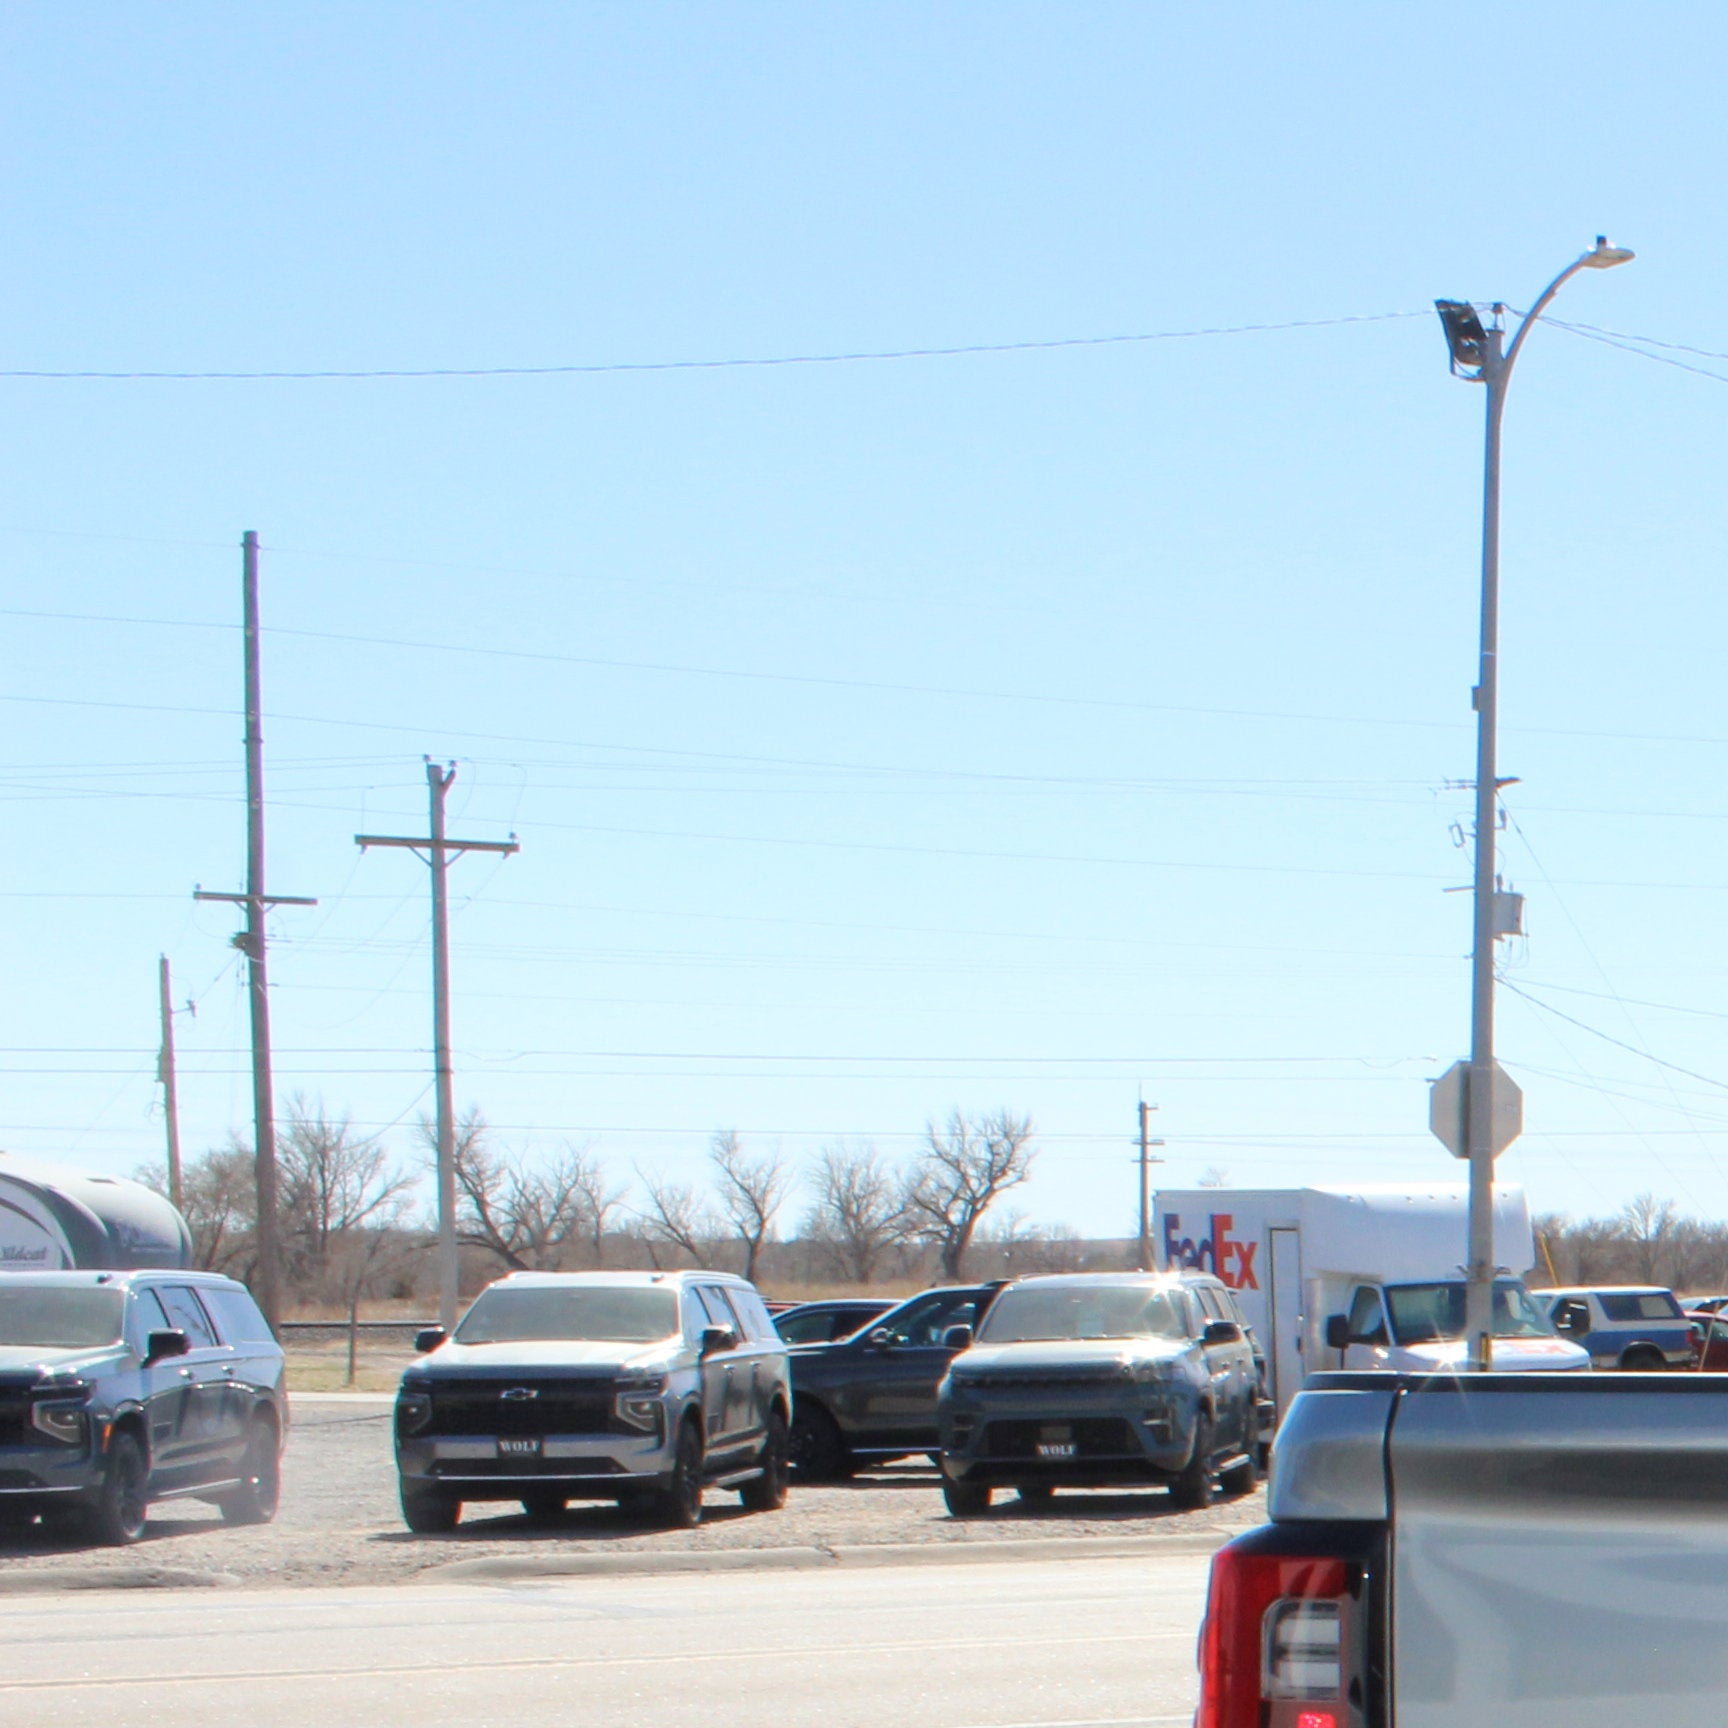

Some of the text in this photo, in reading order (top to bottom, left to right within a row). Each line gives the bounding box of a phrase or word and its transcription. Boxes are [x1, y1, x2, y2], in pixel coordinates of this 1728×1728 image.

[1163, 1213, 1258, 1289] FedEx
[499, 1440, 540, 1452] WOLF
[1036, 1444, 1078, 1456] WOLF
